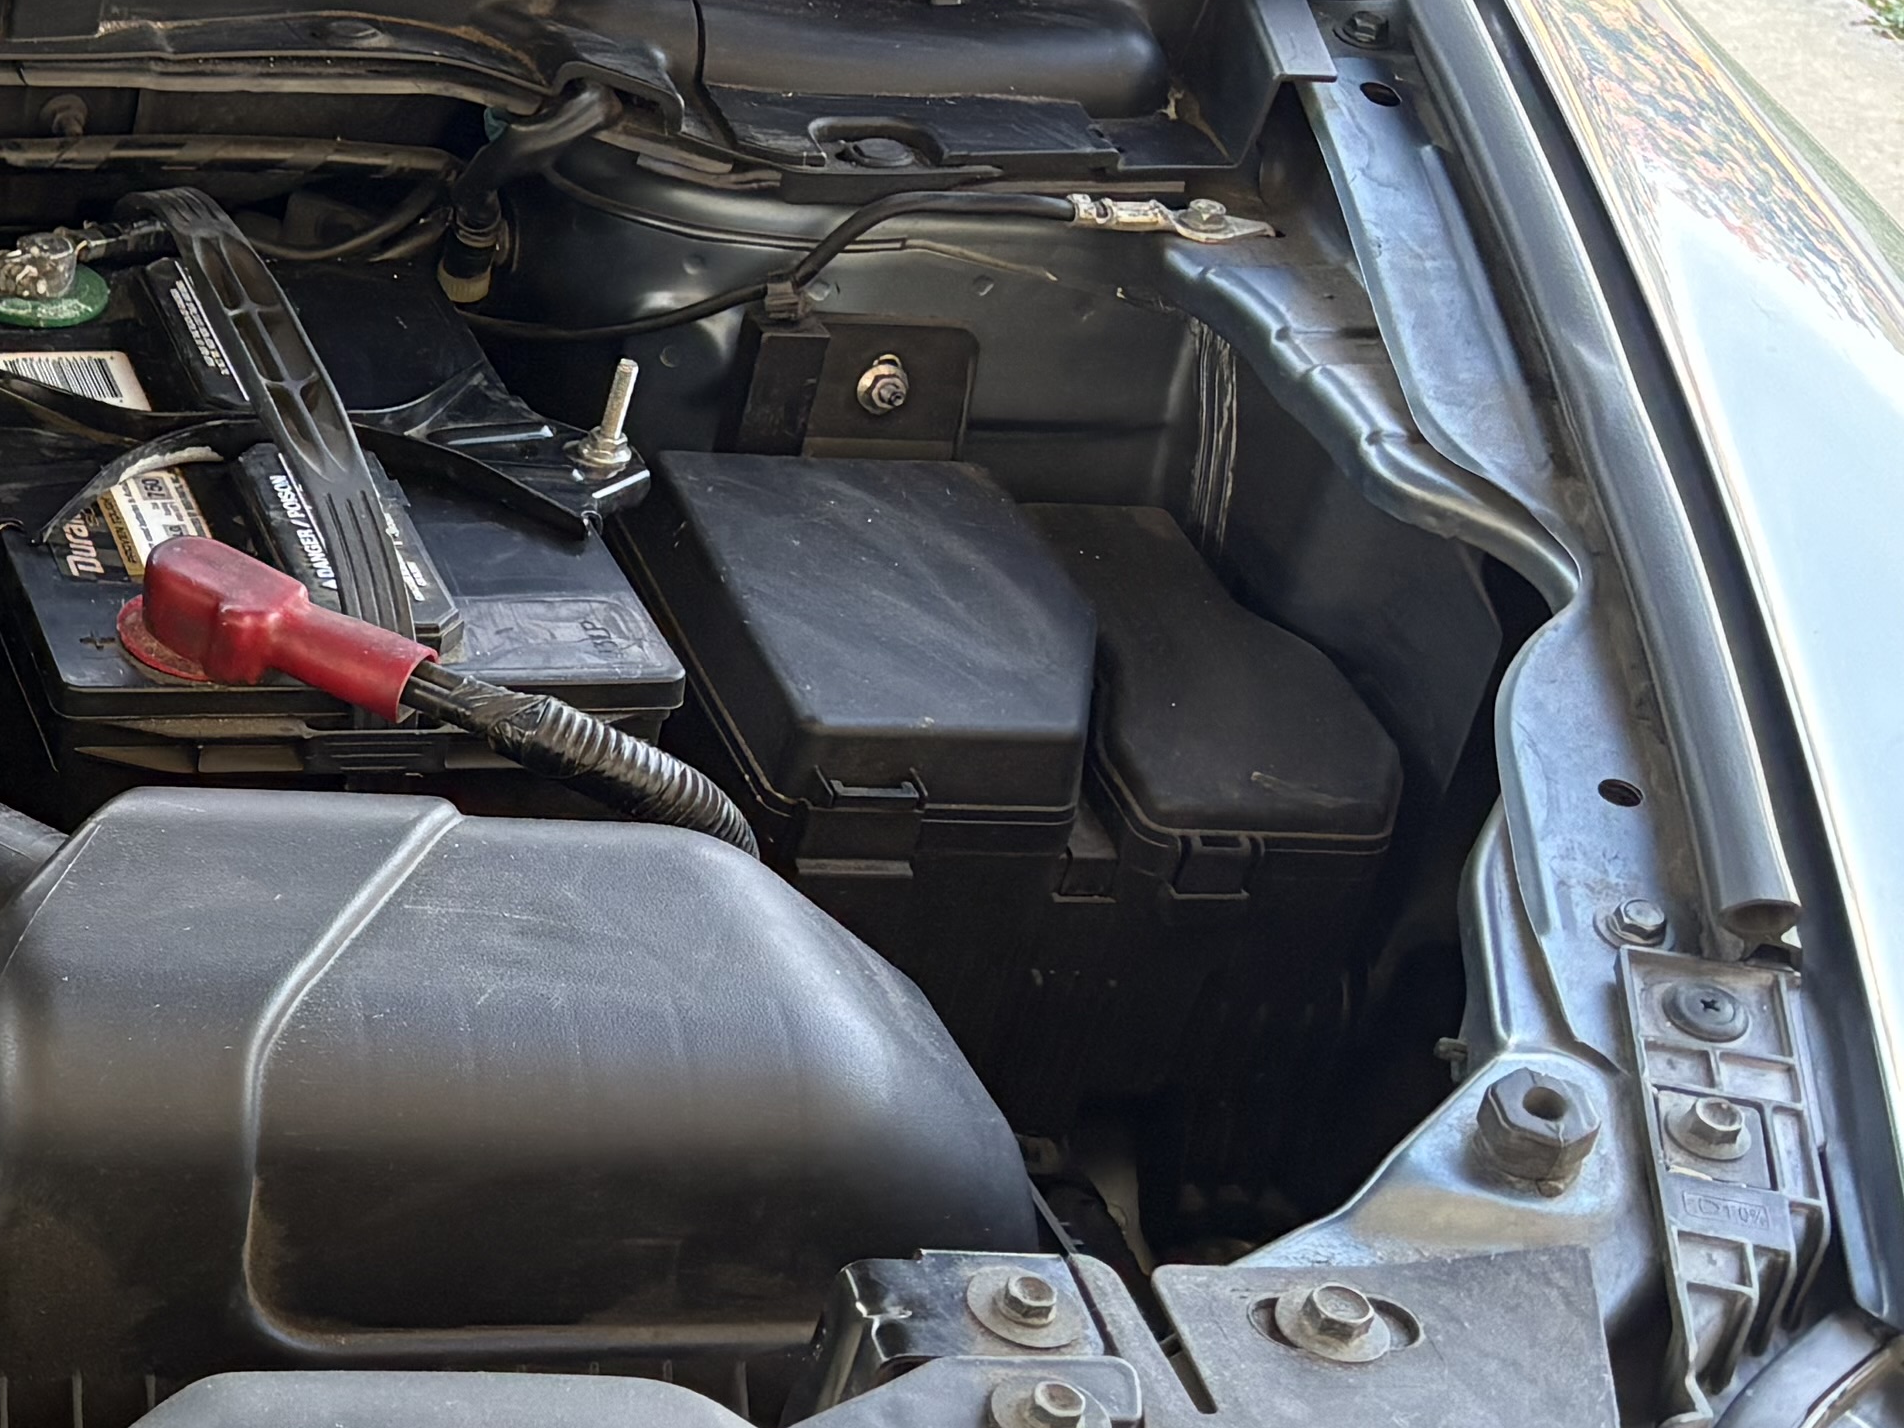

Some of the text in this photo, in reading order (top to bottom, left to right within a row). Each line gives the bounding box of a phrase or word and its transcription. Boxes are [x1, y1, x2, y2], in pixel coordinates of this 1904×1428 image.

[141, 478, 166, 498] 750
[269, 474, 306, 518] POISON
[296, 529, 335, 578] DANGER
